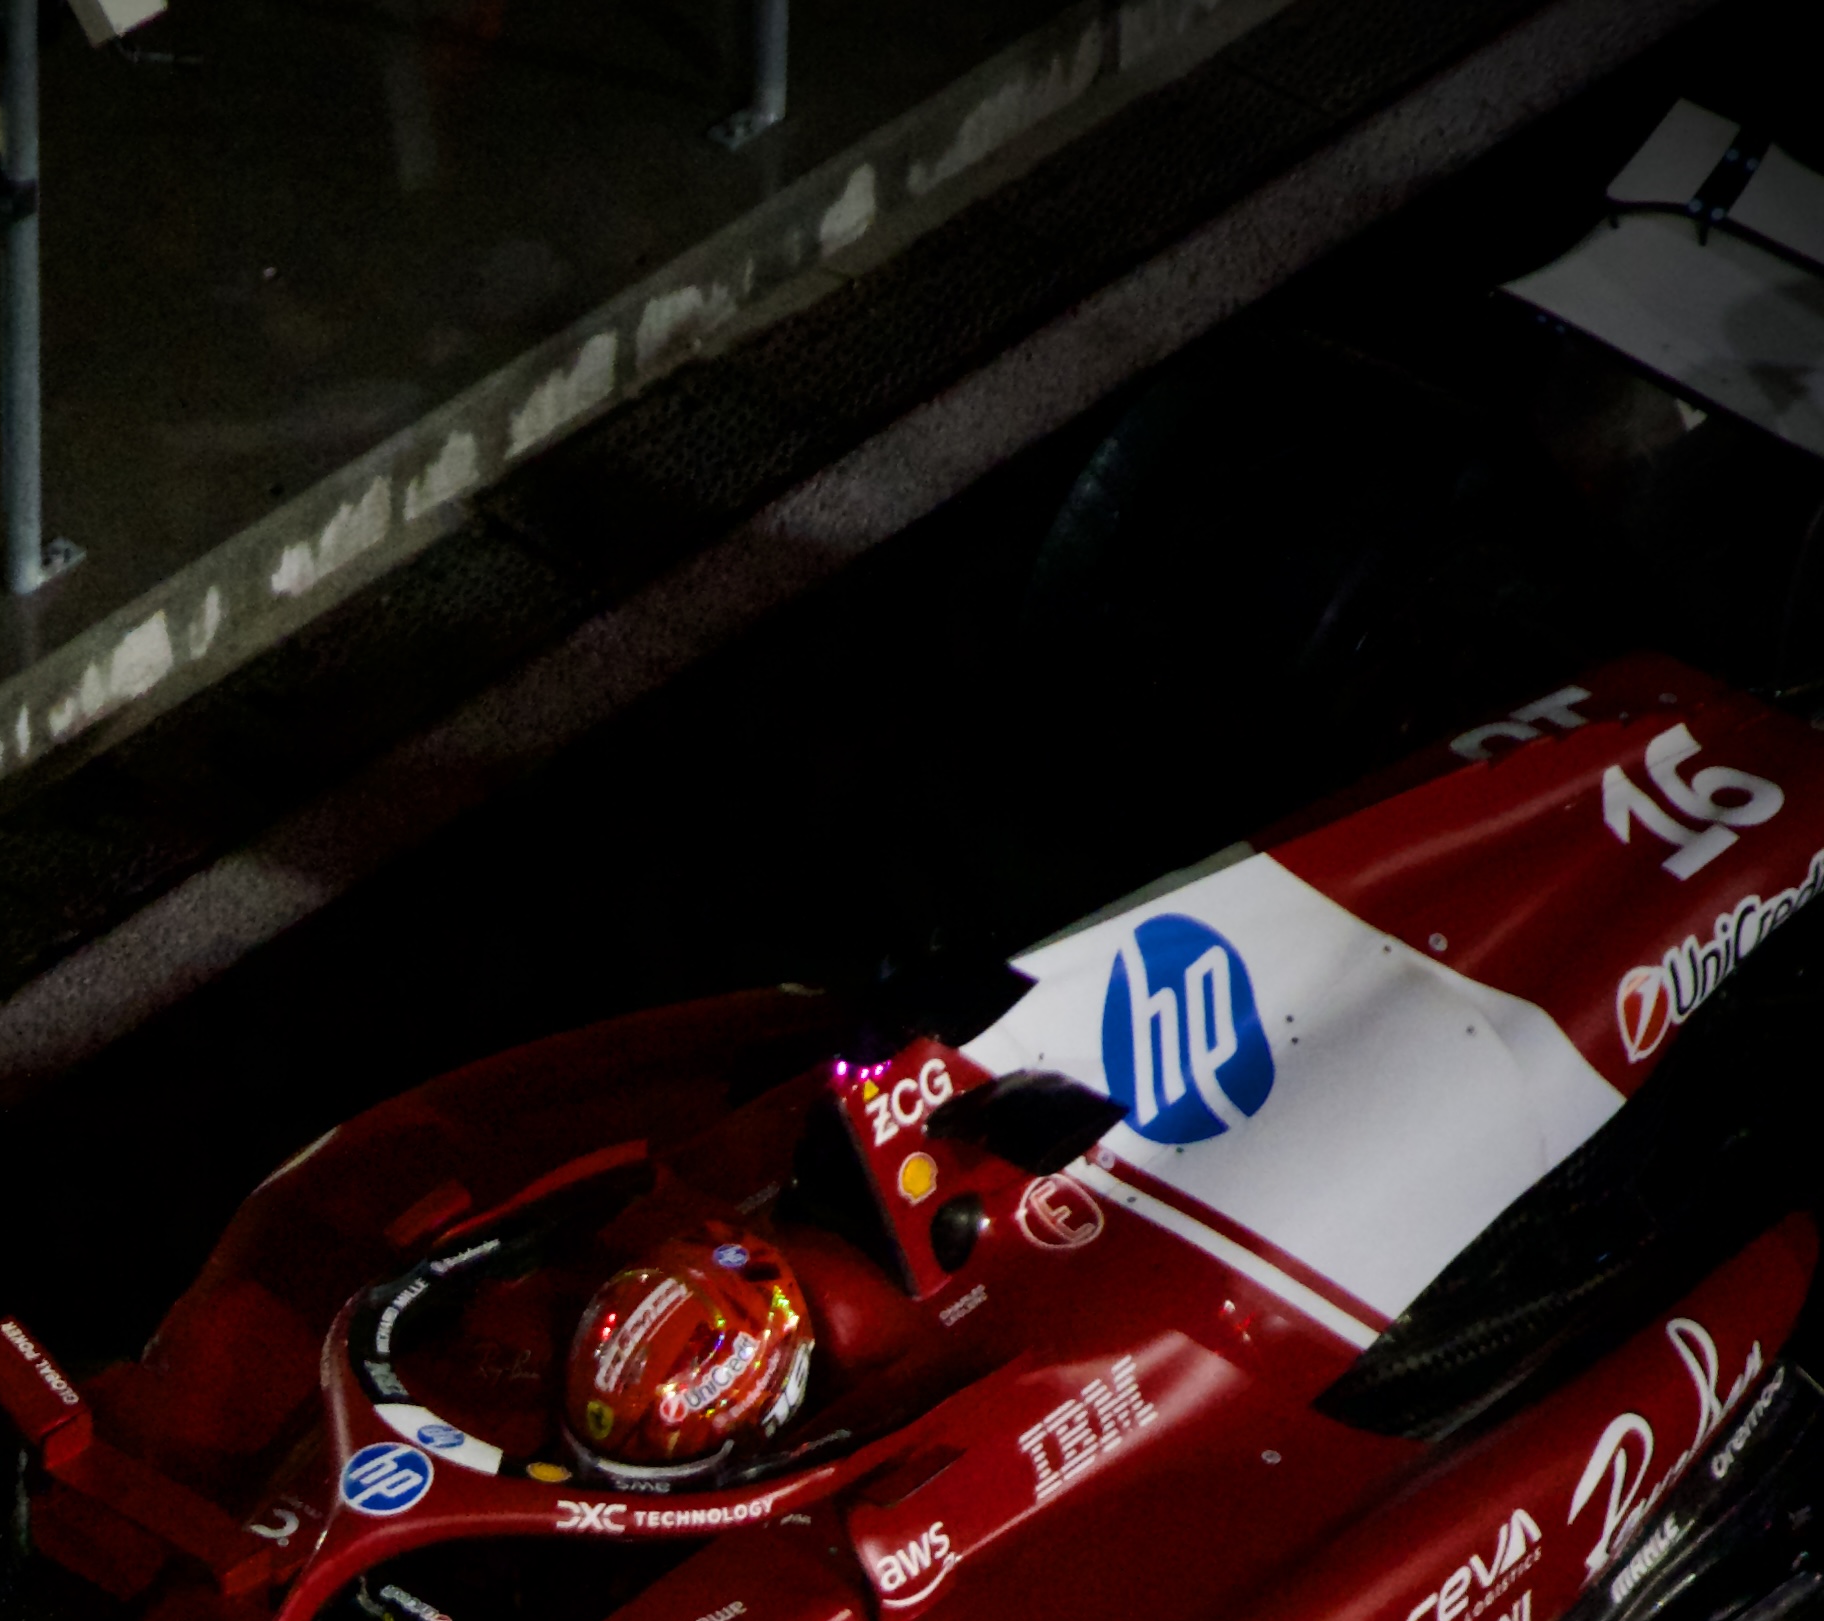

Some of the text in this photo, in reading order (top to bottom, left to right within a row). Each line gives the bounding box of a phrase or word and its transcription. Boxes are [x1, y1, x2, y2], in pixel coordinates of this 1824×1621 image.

[1601, 722, 1785, 880] 16
[1664, 850, 1824, 1018] UniCred
[864, 1057, 954, 1147] ZCG
[1017, 1353, 1157, 1502] IBM
[340, 1444, 432, 1514] hp
[632, 1498, 775, 1529] TECHNOLOGY
[877, 1520, 953, 1596] aws
